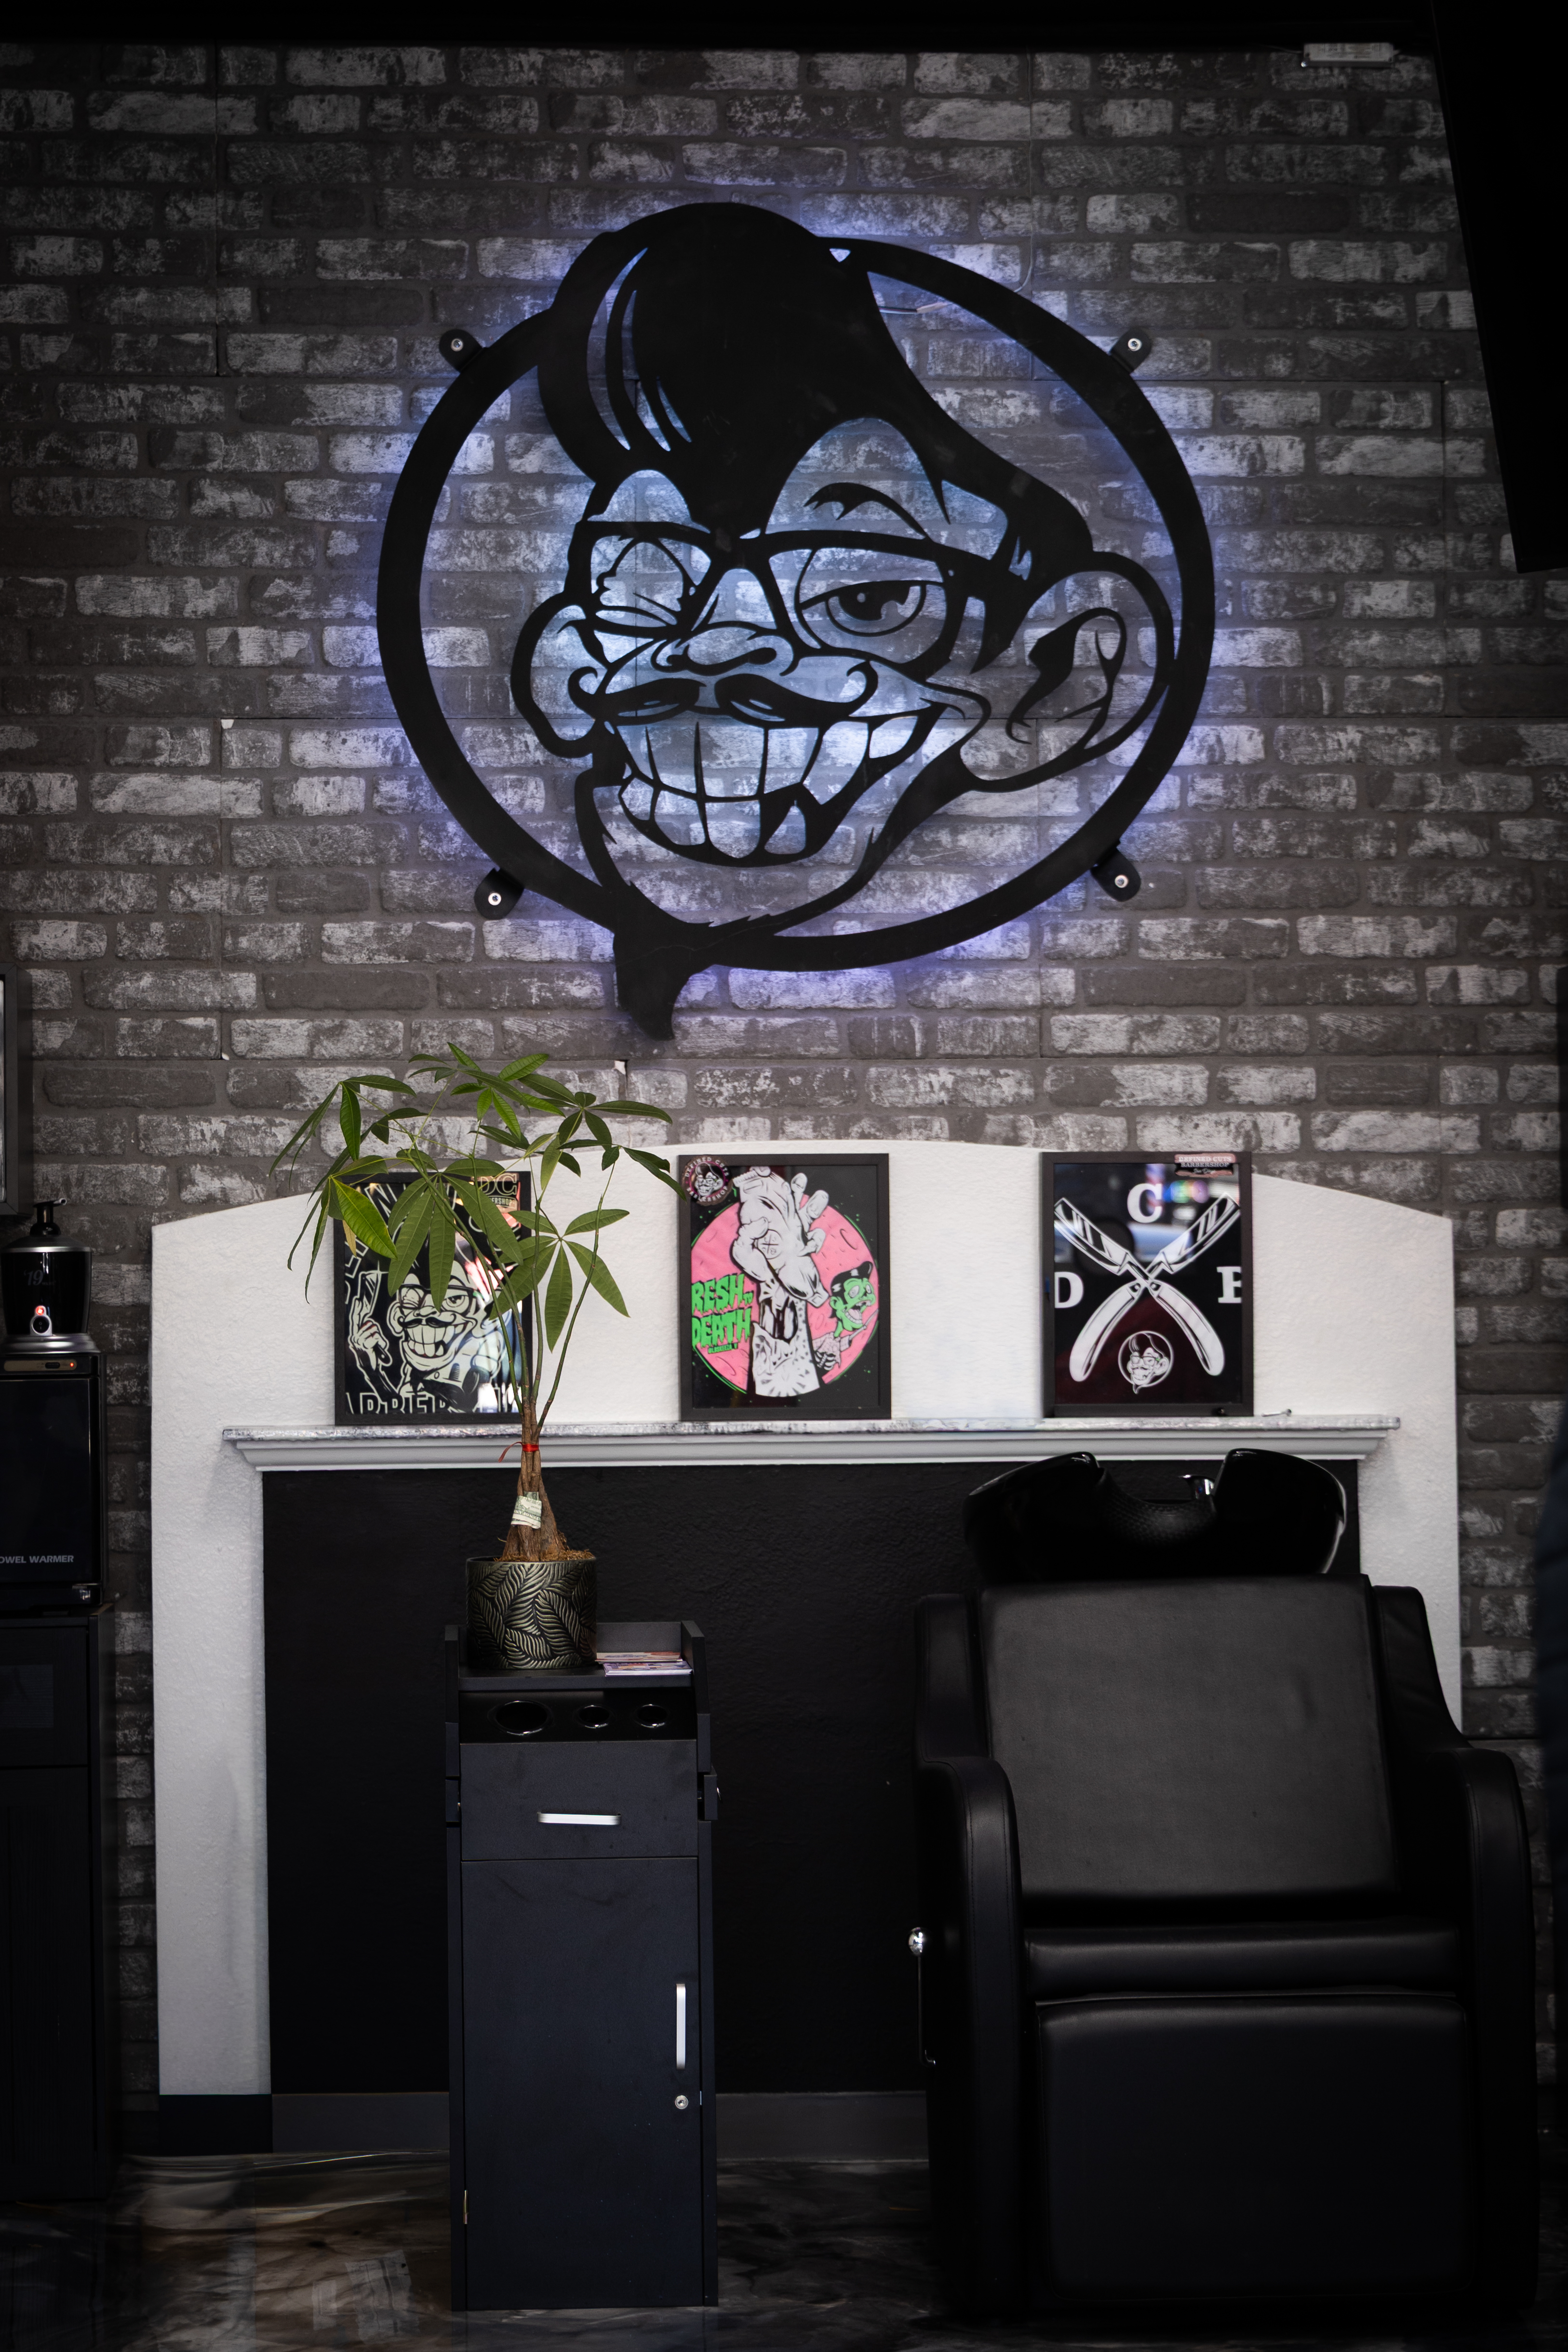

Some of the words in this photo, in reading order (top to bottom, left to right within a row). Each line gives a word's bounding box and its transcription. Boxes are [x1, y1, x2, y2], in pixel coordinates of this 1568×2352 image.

[684, 1157, 711, 1177] DEFINED
[715, 1160, 729, 1176] CUTS
[1127, 1183, 1162, 1223] C
[1054, 1271, 1084, 1309] D
[692, 1307, 752, 1348] DEATH
